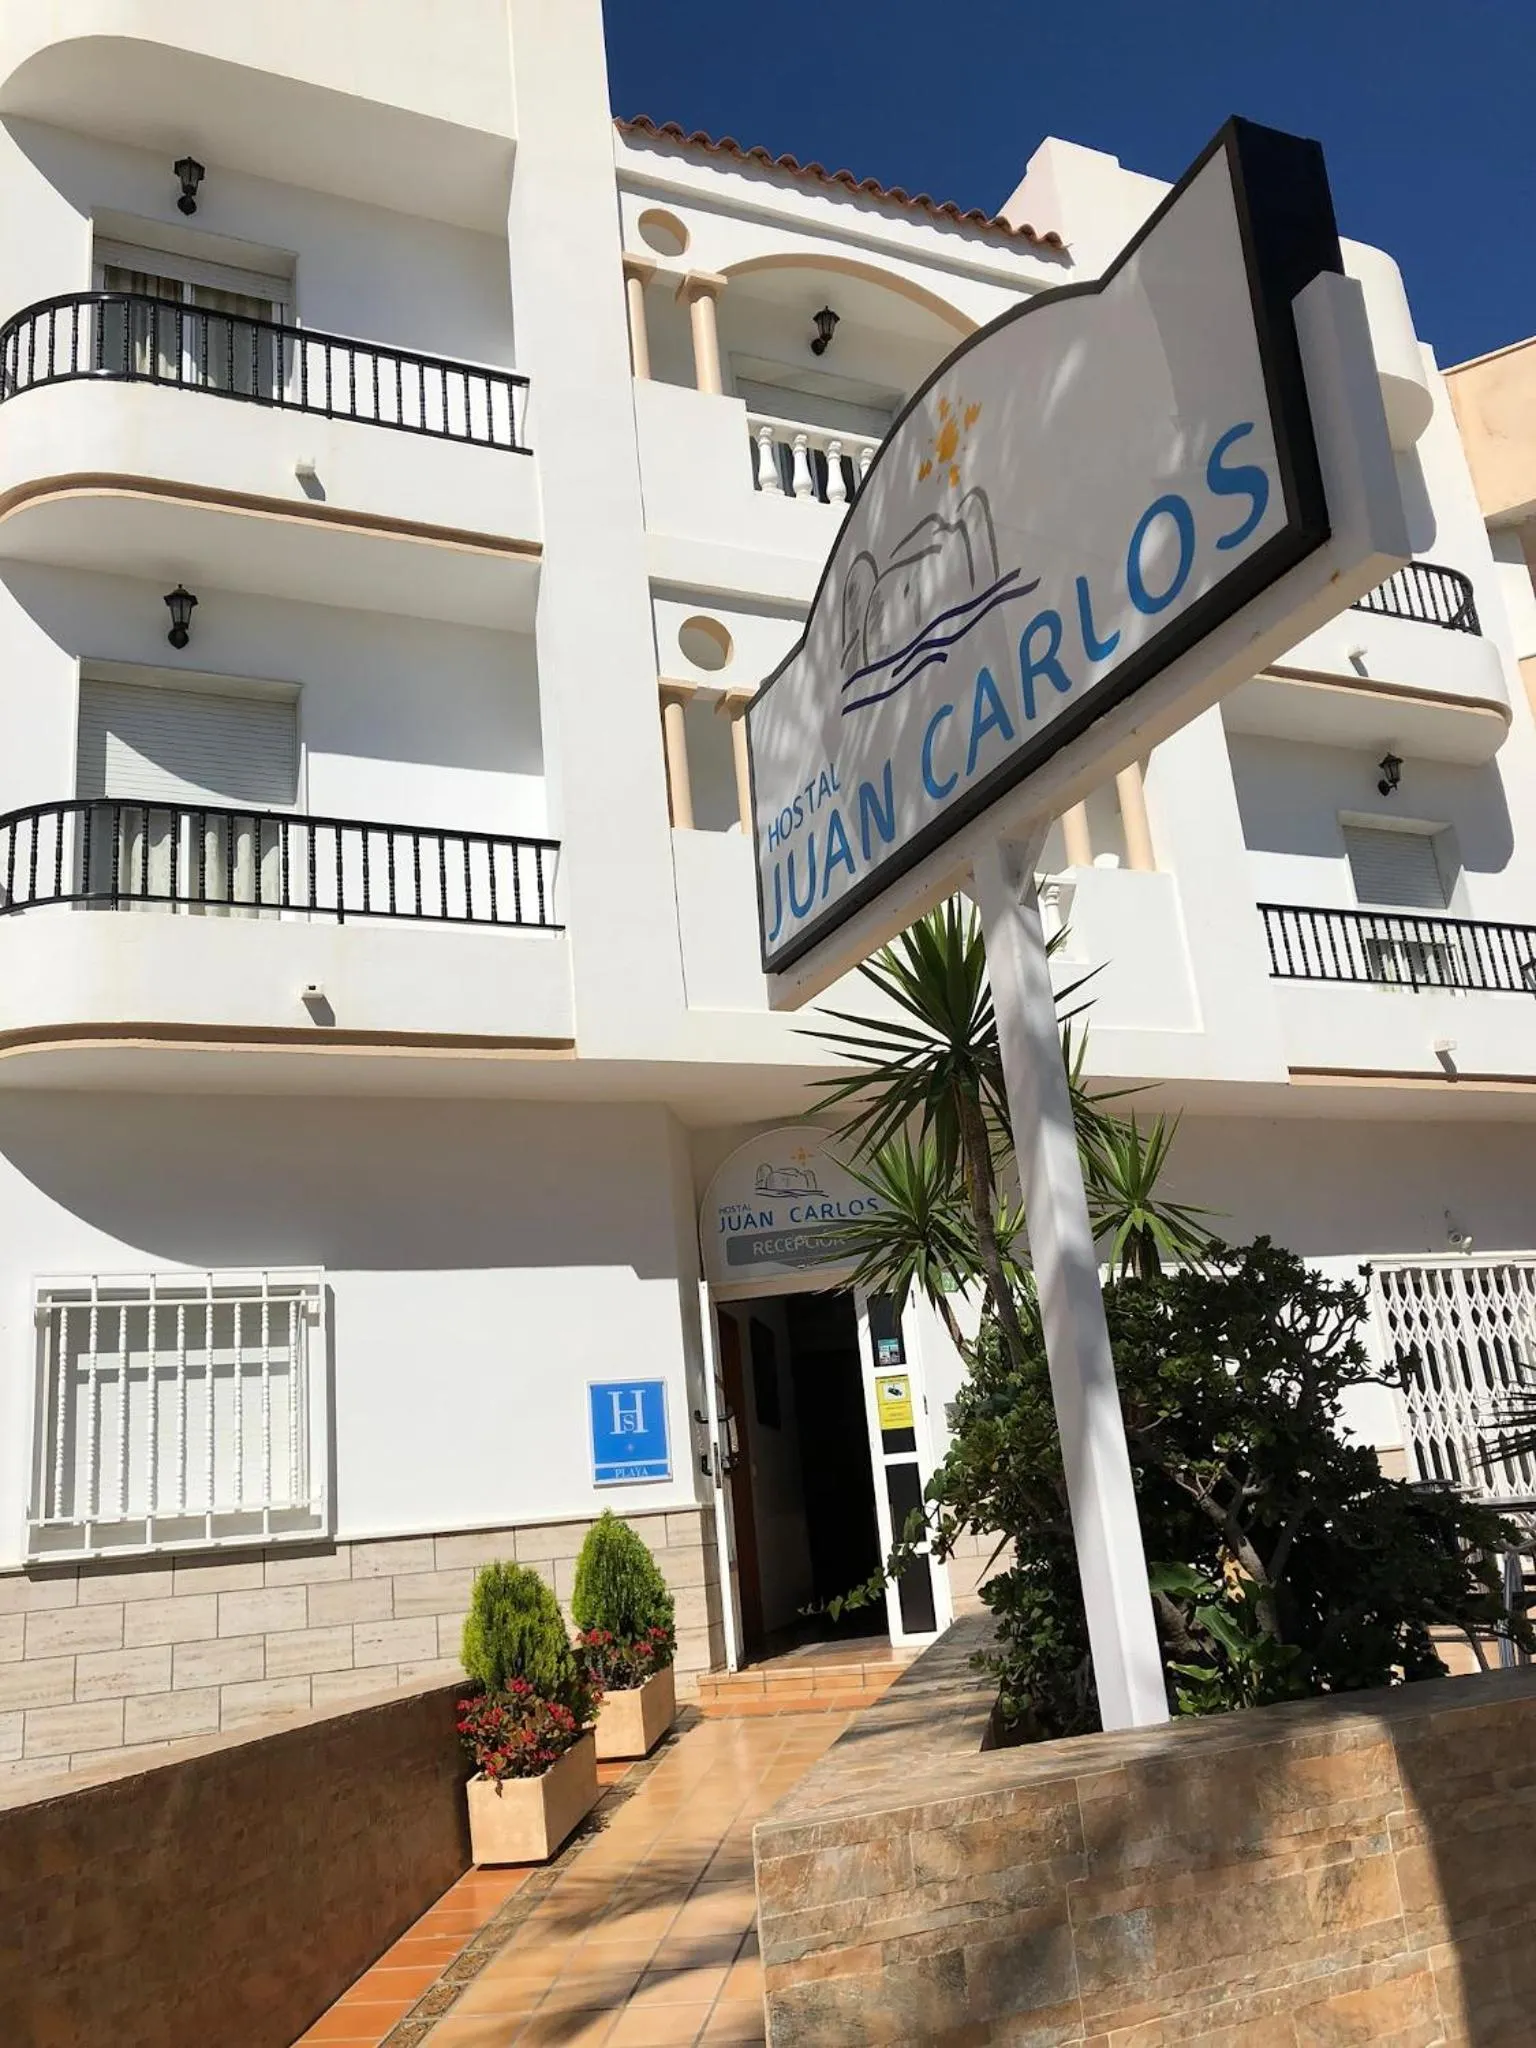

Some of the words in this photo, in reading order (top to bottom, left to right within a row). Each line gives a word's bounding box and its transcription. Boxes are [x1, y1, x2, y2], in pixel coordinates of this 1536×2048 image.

[768, 760, 895, 942] JUAN
[921, 421, 1270, 800] CARLOS
[768, 763, 841, 852] HOSTAL
[718, 1203, 752, 1215] HOSTAL
[719, 1210, 773, 1233] JUAN
[790, 1198, 879, 1223] CARLOS
[615, 1467, 649, 1479] PLAYA
